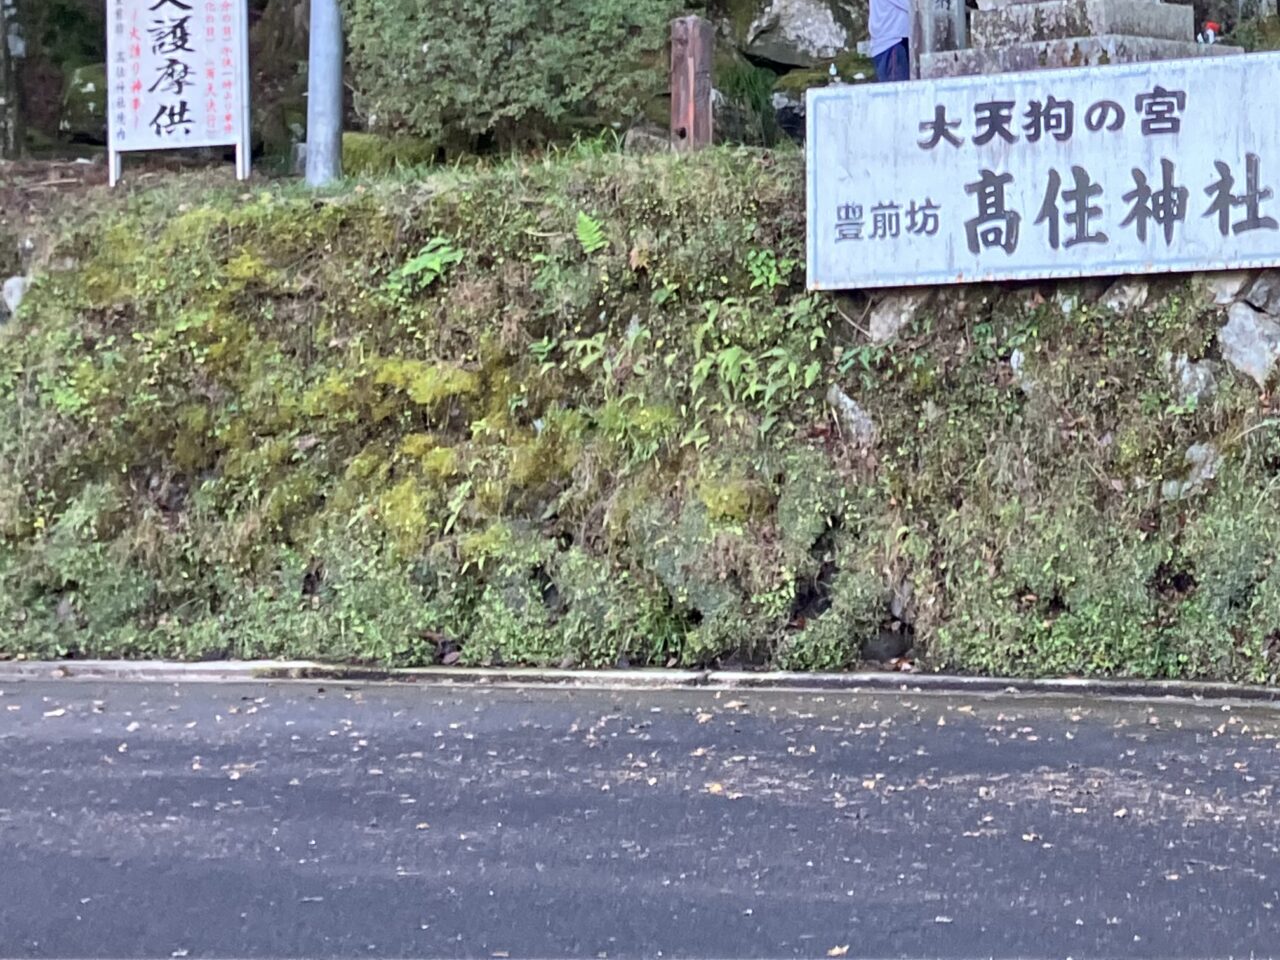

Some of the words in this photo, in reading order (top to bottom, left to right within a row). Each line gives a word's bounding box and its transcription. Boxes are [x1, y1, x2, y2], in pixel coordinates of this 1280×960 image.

[917, 85, 1186, 150] 大天狗の宮
[834, 196, 943, 243] 豊前坊
